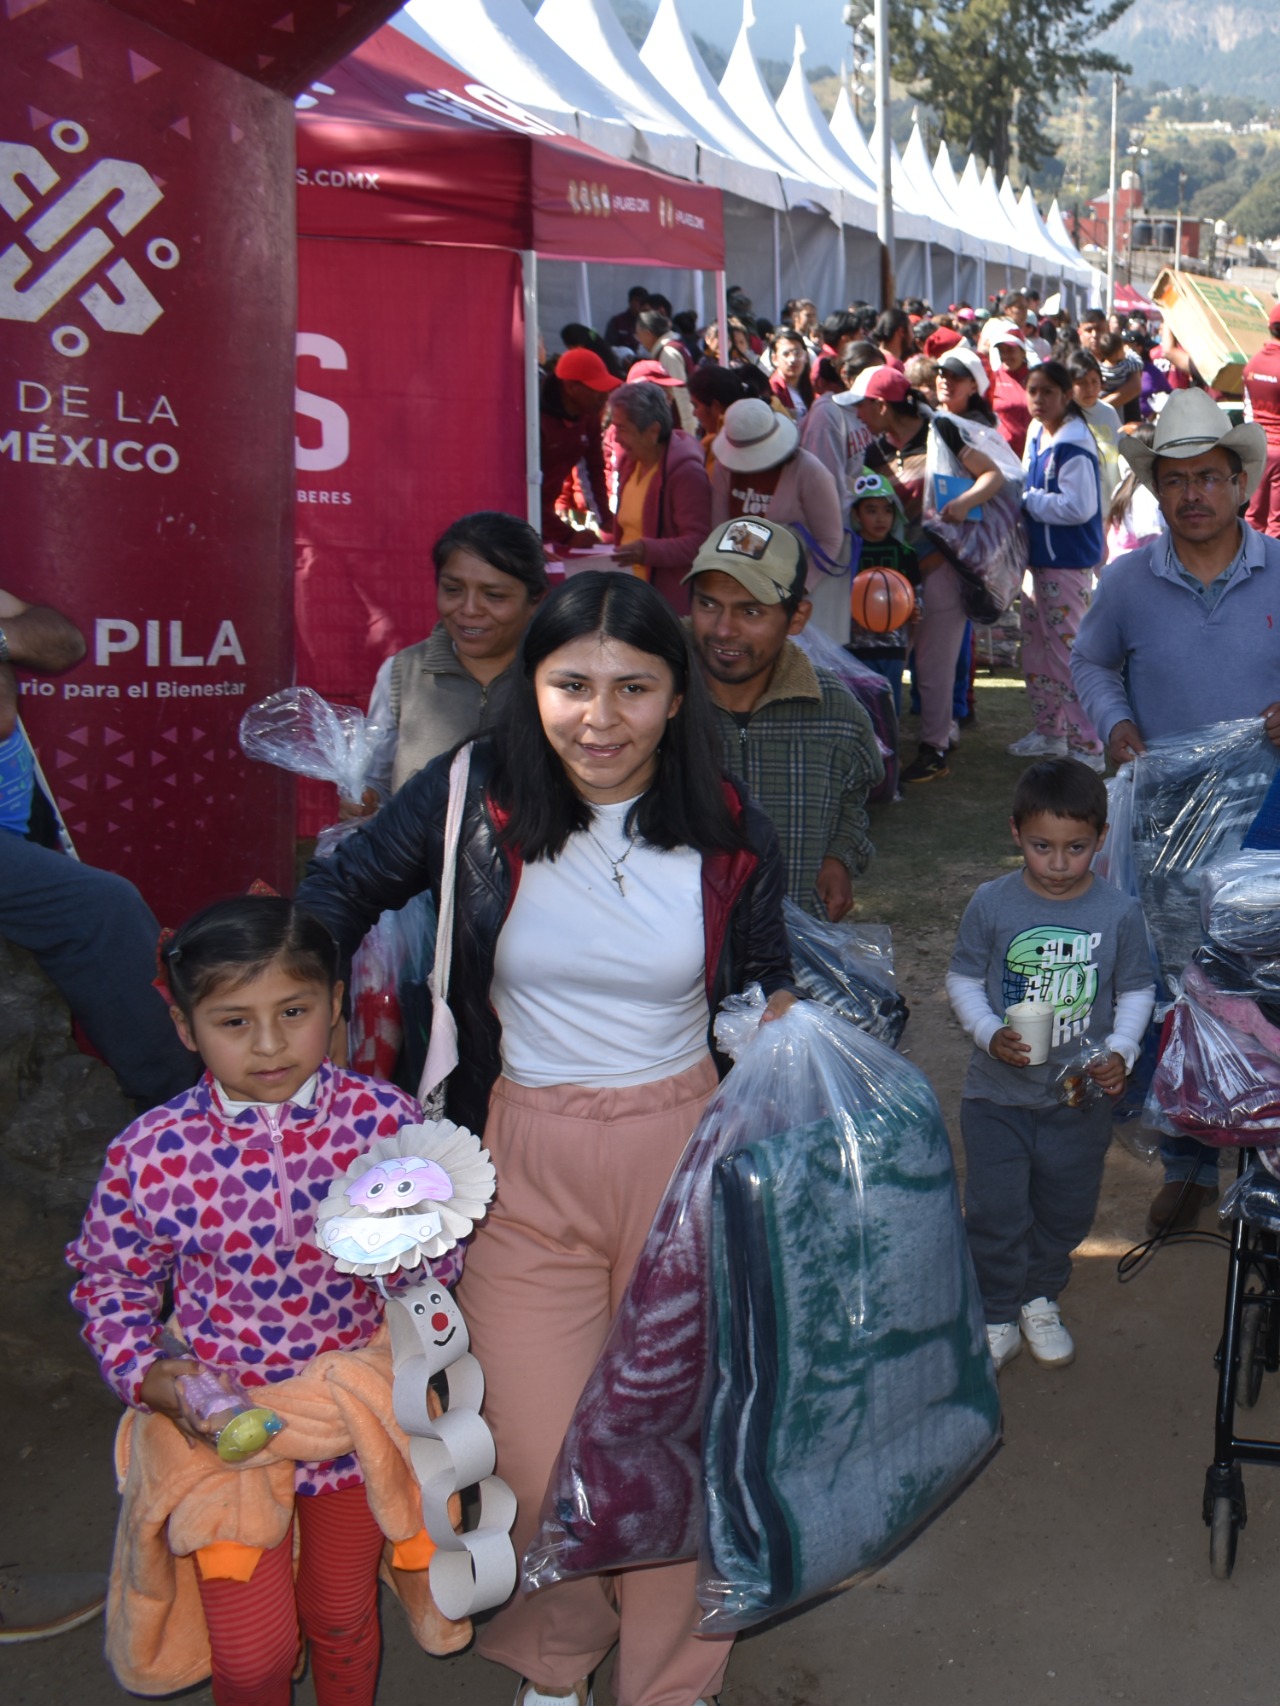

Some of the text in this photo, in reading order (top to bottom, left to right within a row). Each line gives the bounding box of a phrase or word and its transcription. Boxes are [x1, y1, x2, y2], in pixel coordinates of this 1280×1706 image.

[295, 168, 381, 190] S.CDMX
[18, 380, 180, 427] DE LA
[0, 424, 180, 475] MÉXICO
[95, 618, 246, 667] PILA
[63, 682, 121, 700] para
[127, 681, 149, 699] el
[156, 680, 247, 699] Bienestar
[1041, 932, 1102, 969] SLAP
[1024, 962, 1099, 1005] SHOT
